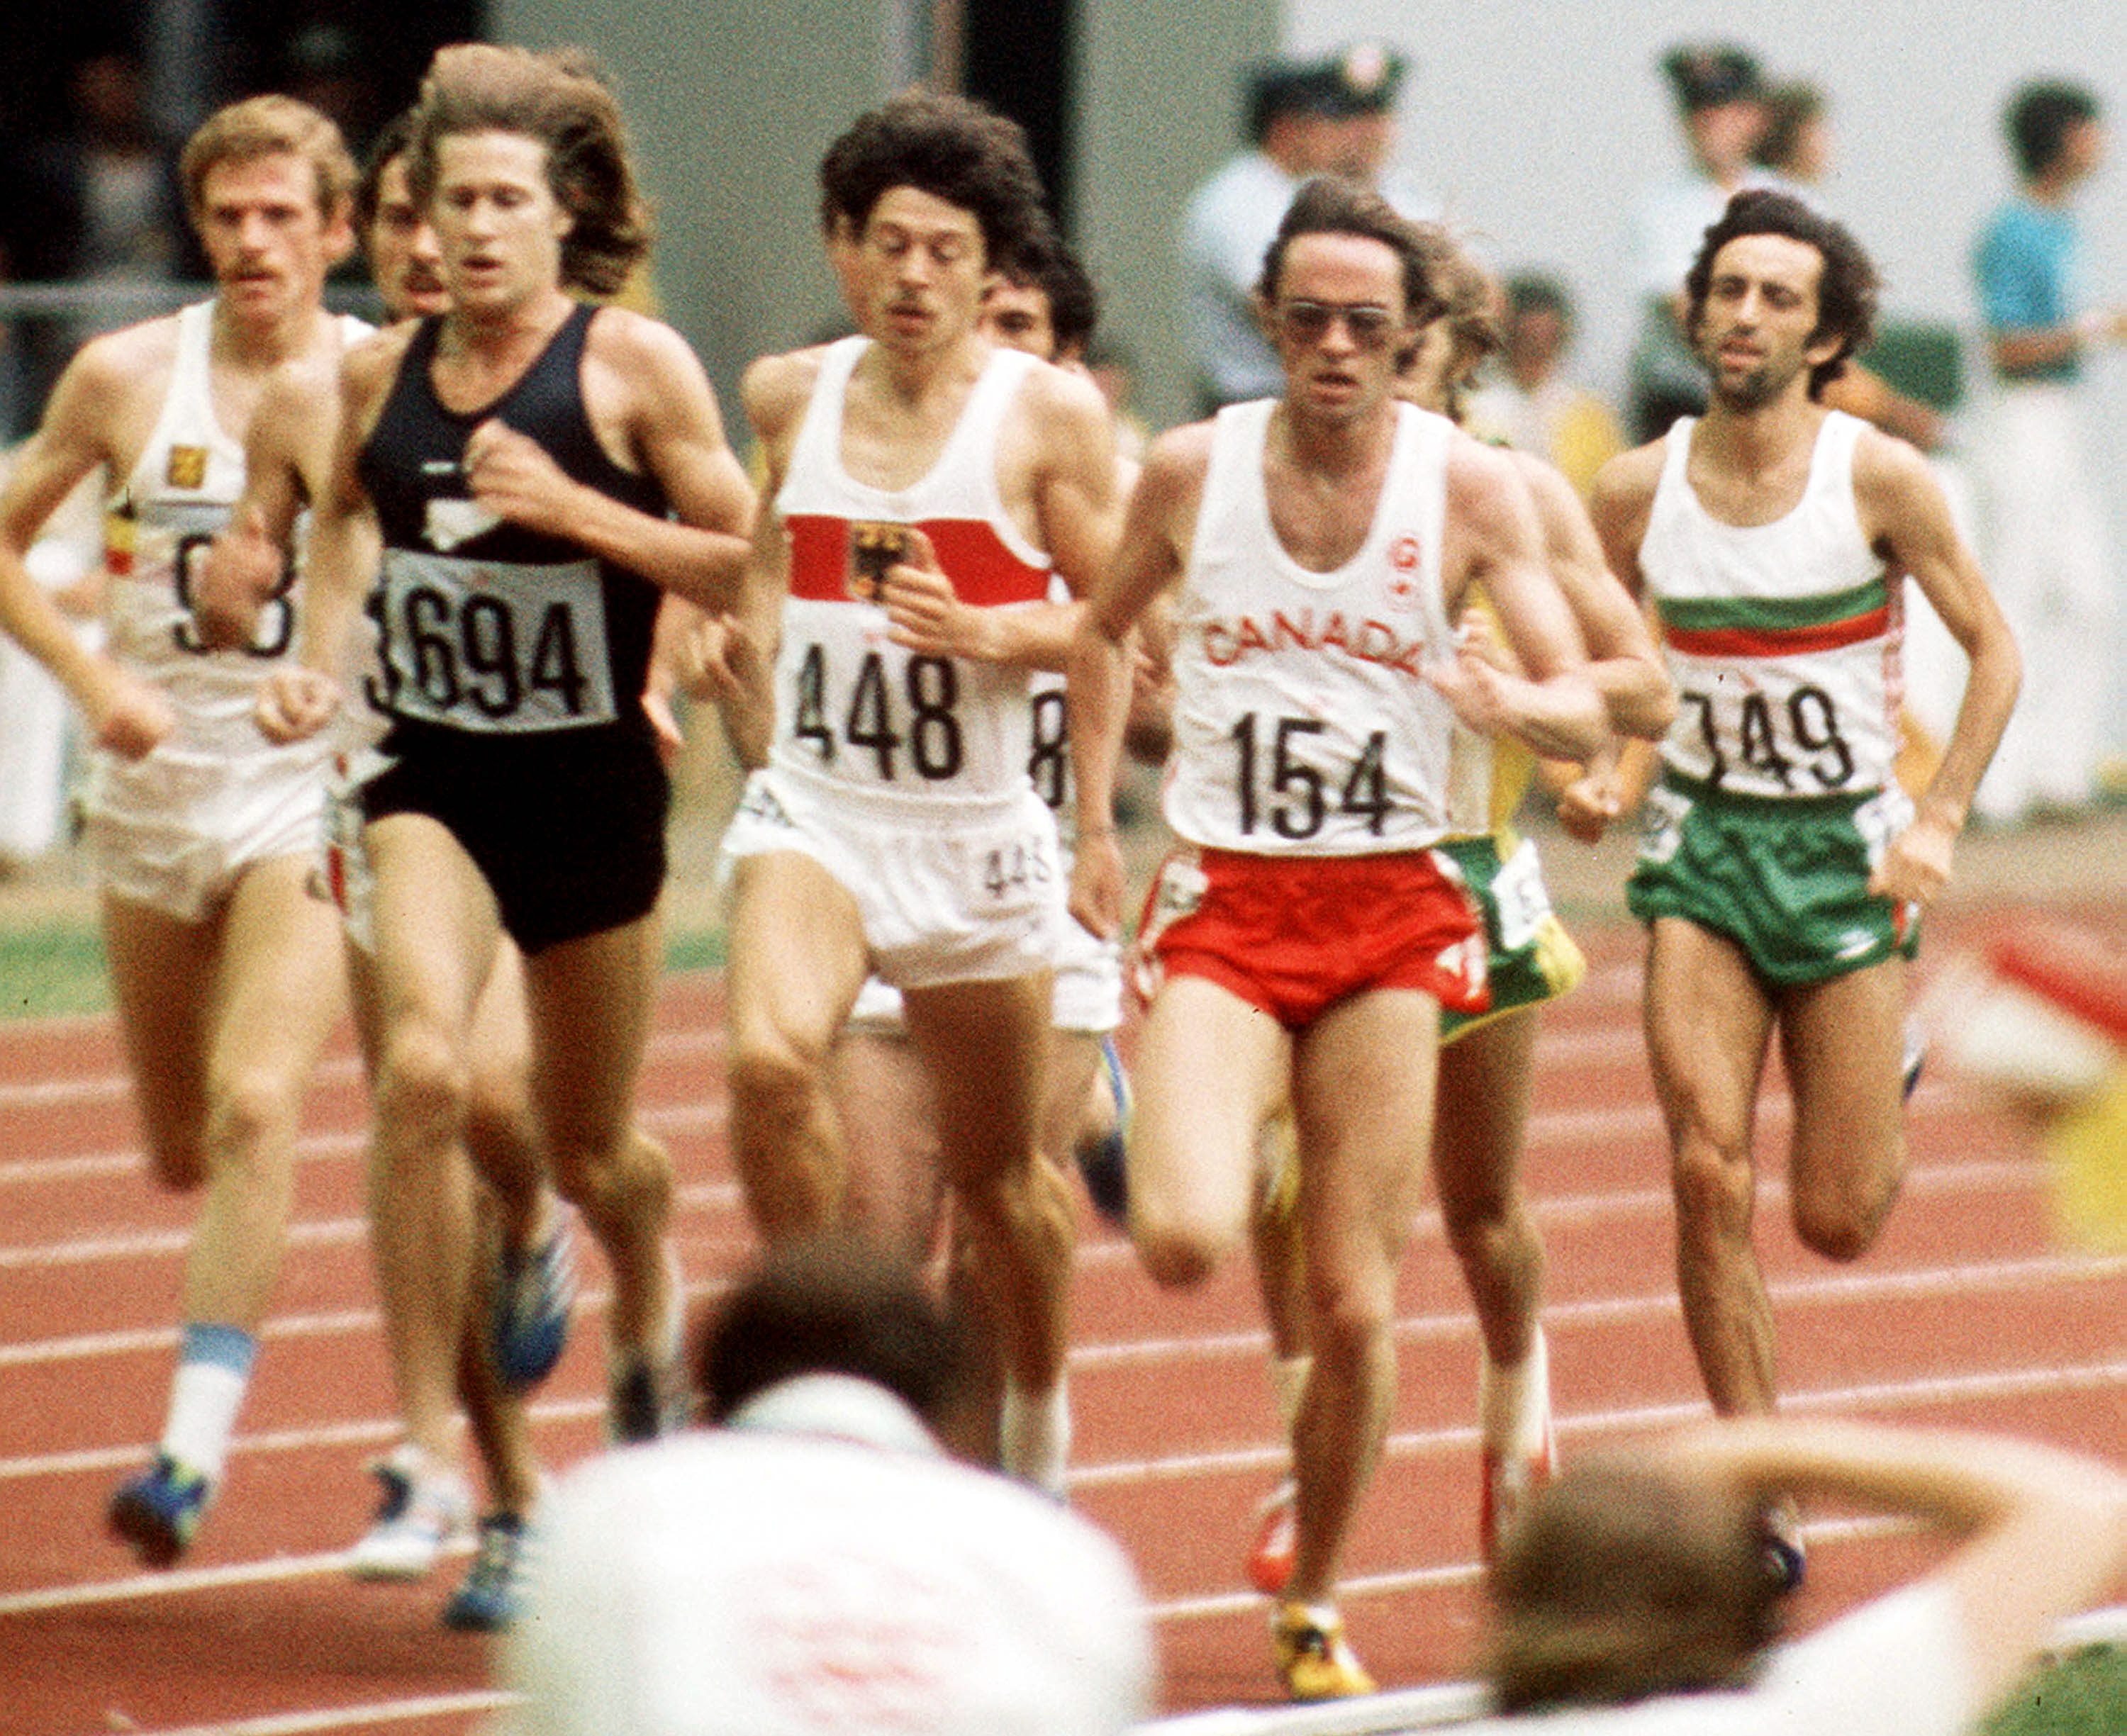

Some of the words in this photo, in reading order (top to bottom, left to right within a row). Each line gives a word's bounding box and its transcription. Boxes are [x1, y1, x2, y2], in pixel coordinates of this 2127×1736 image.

[1203, 608, 1422, 675] CANADA
[793, 644, 964, 781] 448
[1230, 710, 1397, 839] 154
